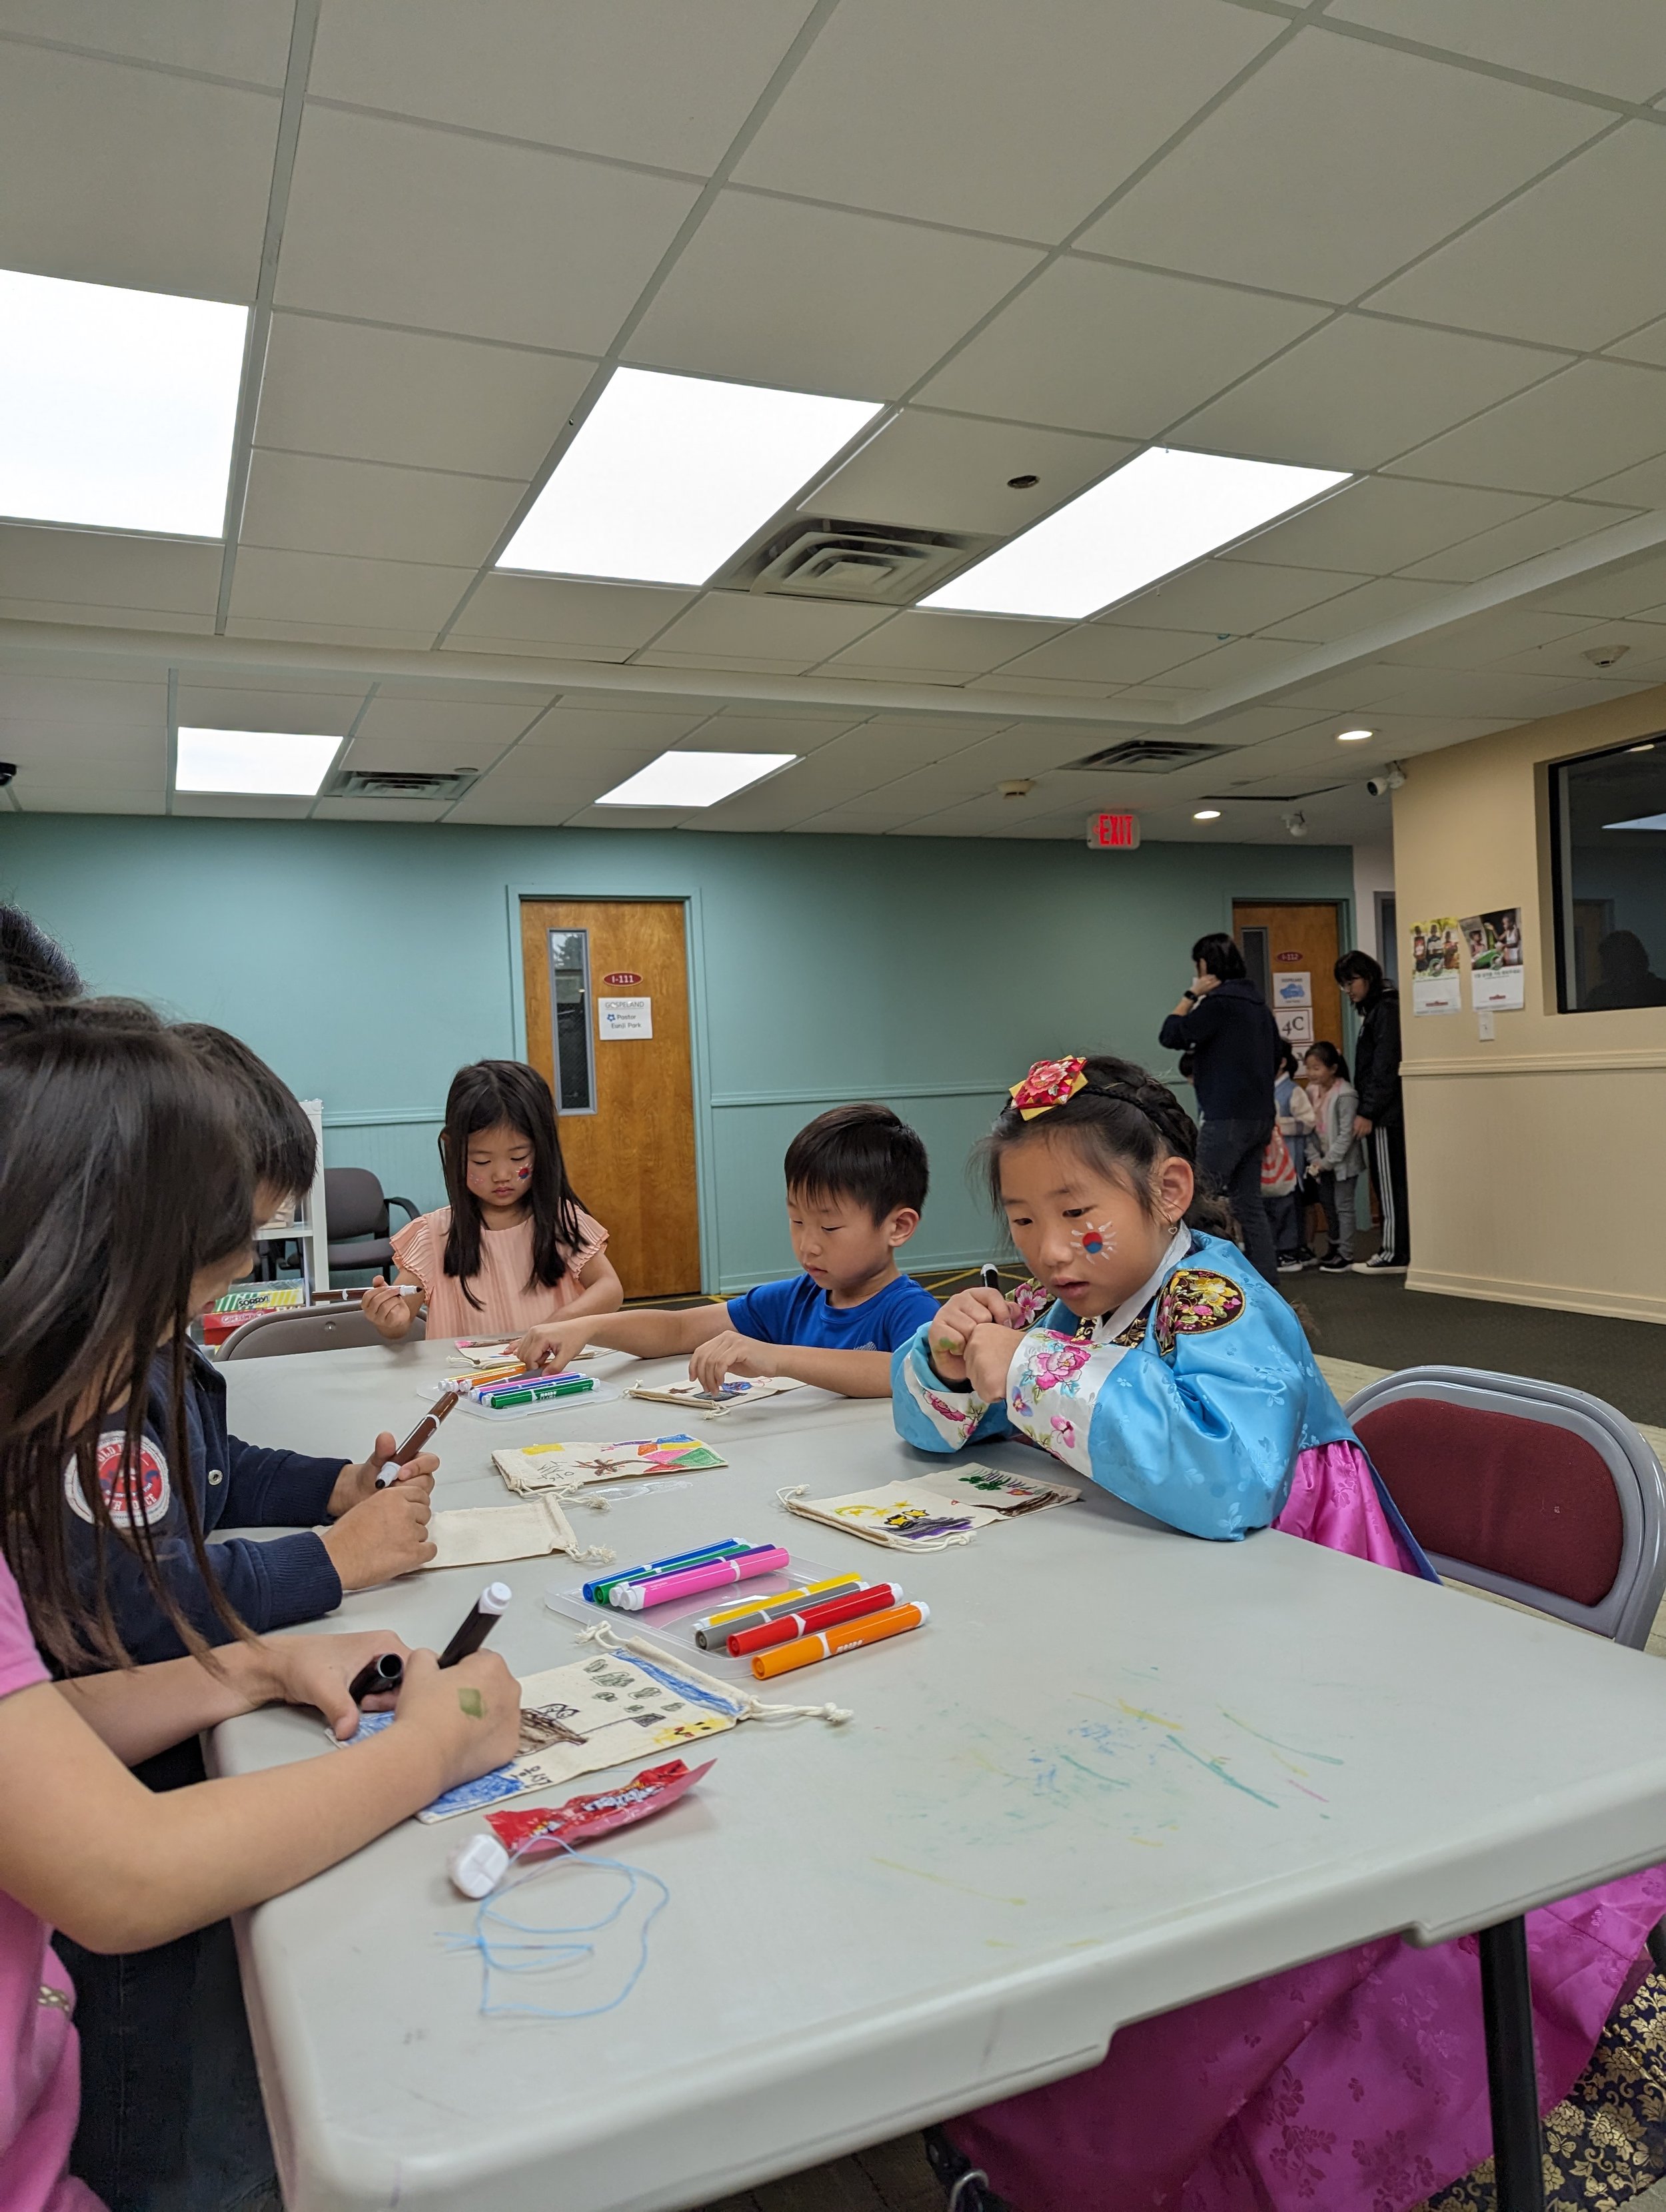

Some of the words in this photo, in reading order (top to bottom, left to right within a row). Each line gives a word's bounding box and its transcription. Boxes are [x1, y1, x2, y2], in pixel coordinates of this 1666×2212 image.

[1099, 814, 1133, 846] EXIT
[1282, 1017, 1304, 1036] 4C
[239, 1295, 269, 1307] SORRY!
